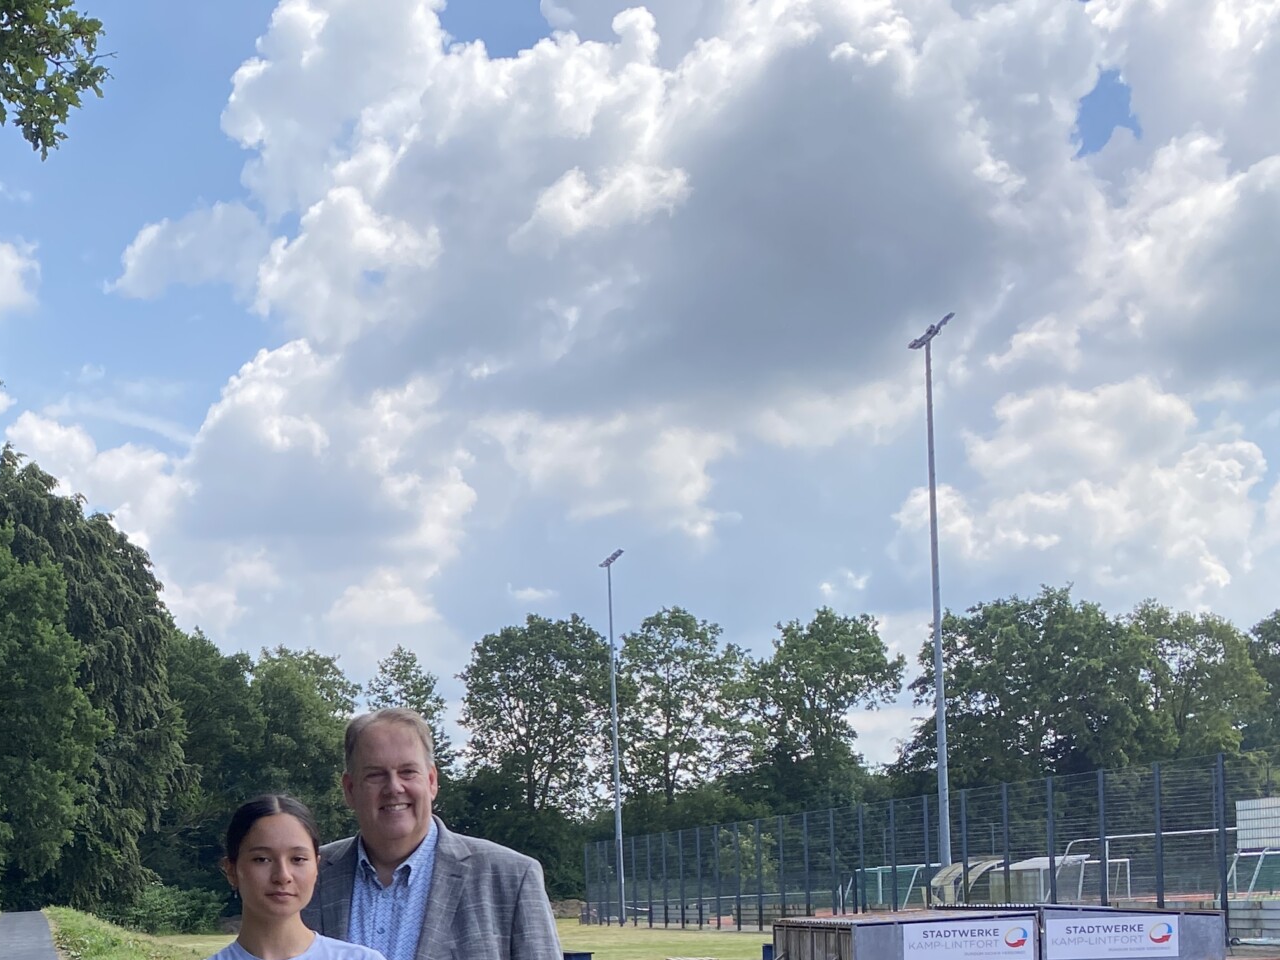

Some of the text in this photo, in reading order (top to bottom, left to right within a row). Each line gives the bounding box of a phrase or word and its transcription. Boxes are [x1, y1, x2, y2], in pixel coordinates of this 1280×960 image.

[922, 928, 1000, 939] STADTWERKE
[1065, 923, 1144, 935] STADTWERKE
[908, 939, 1000, 950] KAMP-LINTFORT
[1051, 934, 1144, 946] KAMP-LINTFORT
